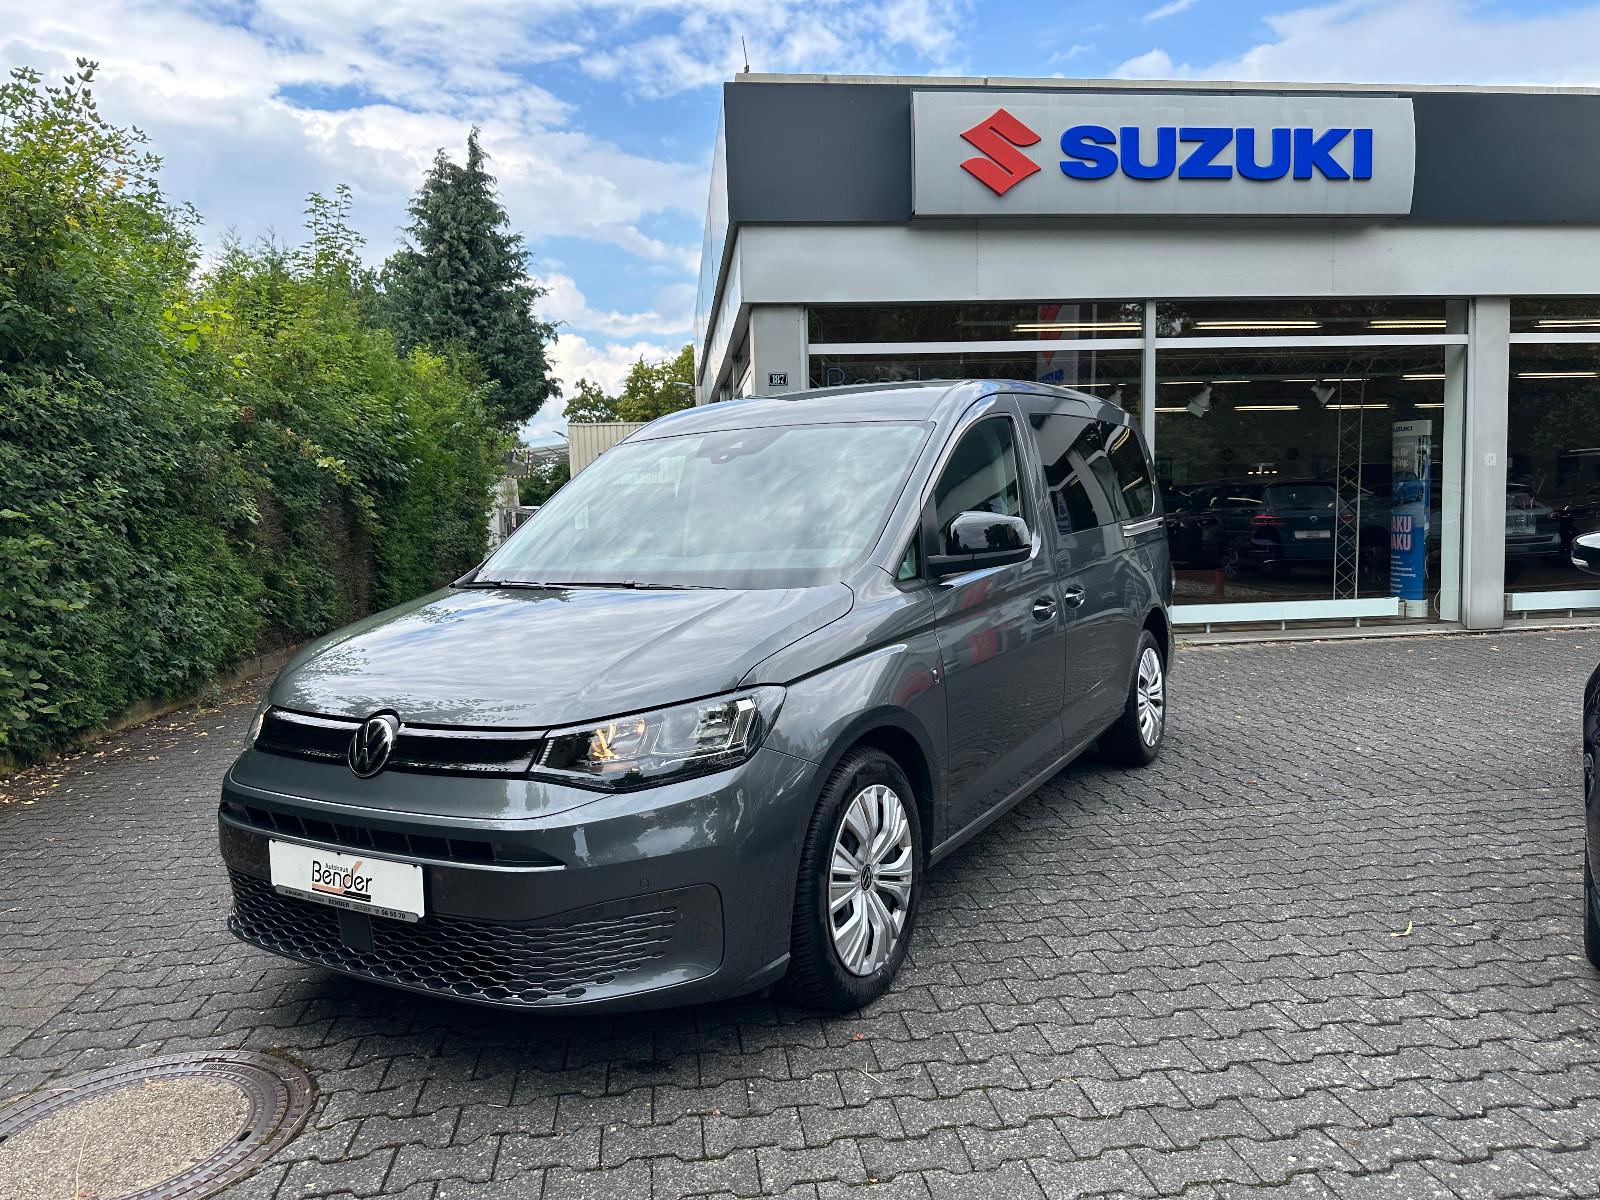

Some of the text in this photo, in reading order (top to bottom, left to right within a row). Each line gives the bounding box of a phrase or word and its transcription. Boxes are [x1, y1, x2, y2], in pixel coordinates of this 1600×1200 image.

[1060, 125, 1373, 181] SUZUKI
[772, 374, 785, 385] 187
[311, 860, 373, 892] Bender
[328, 899, 350, 909] BENDER
